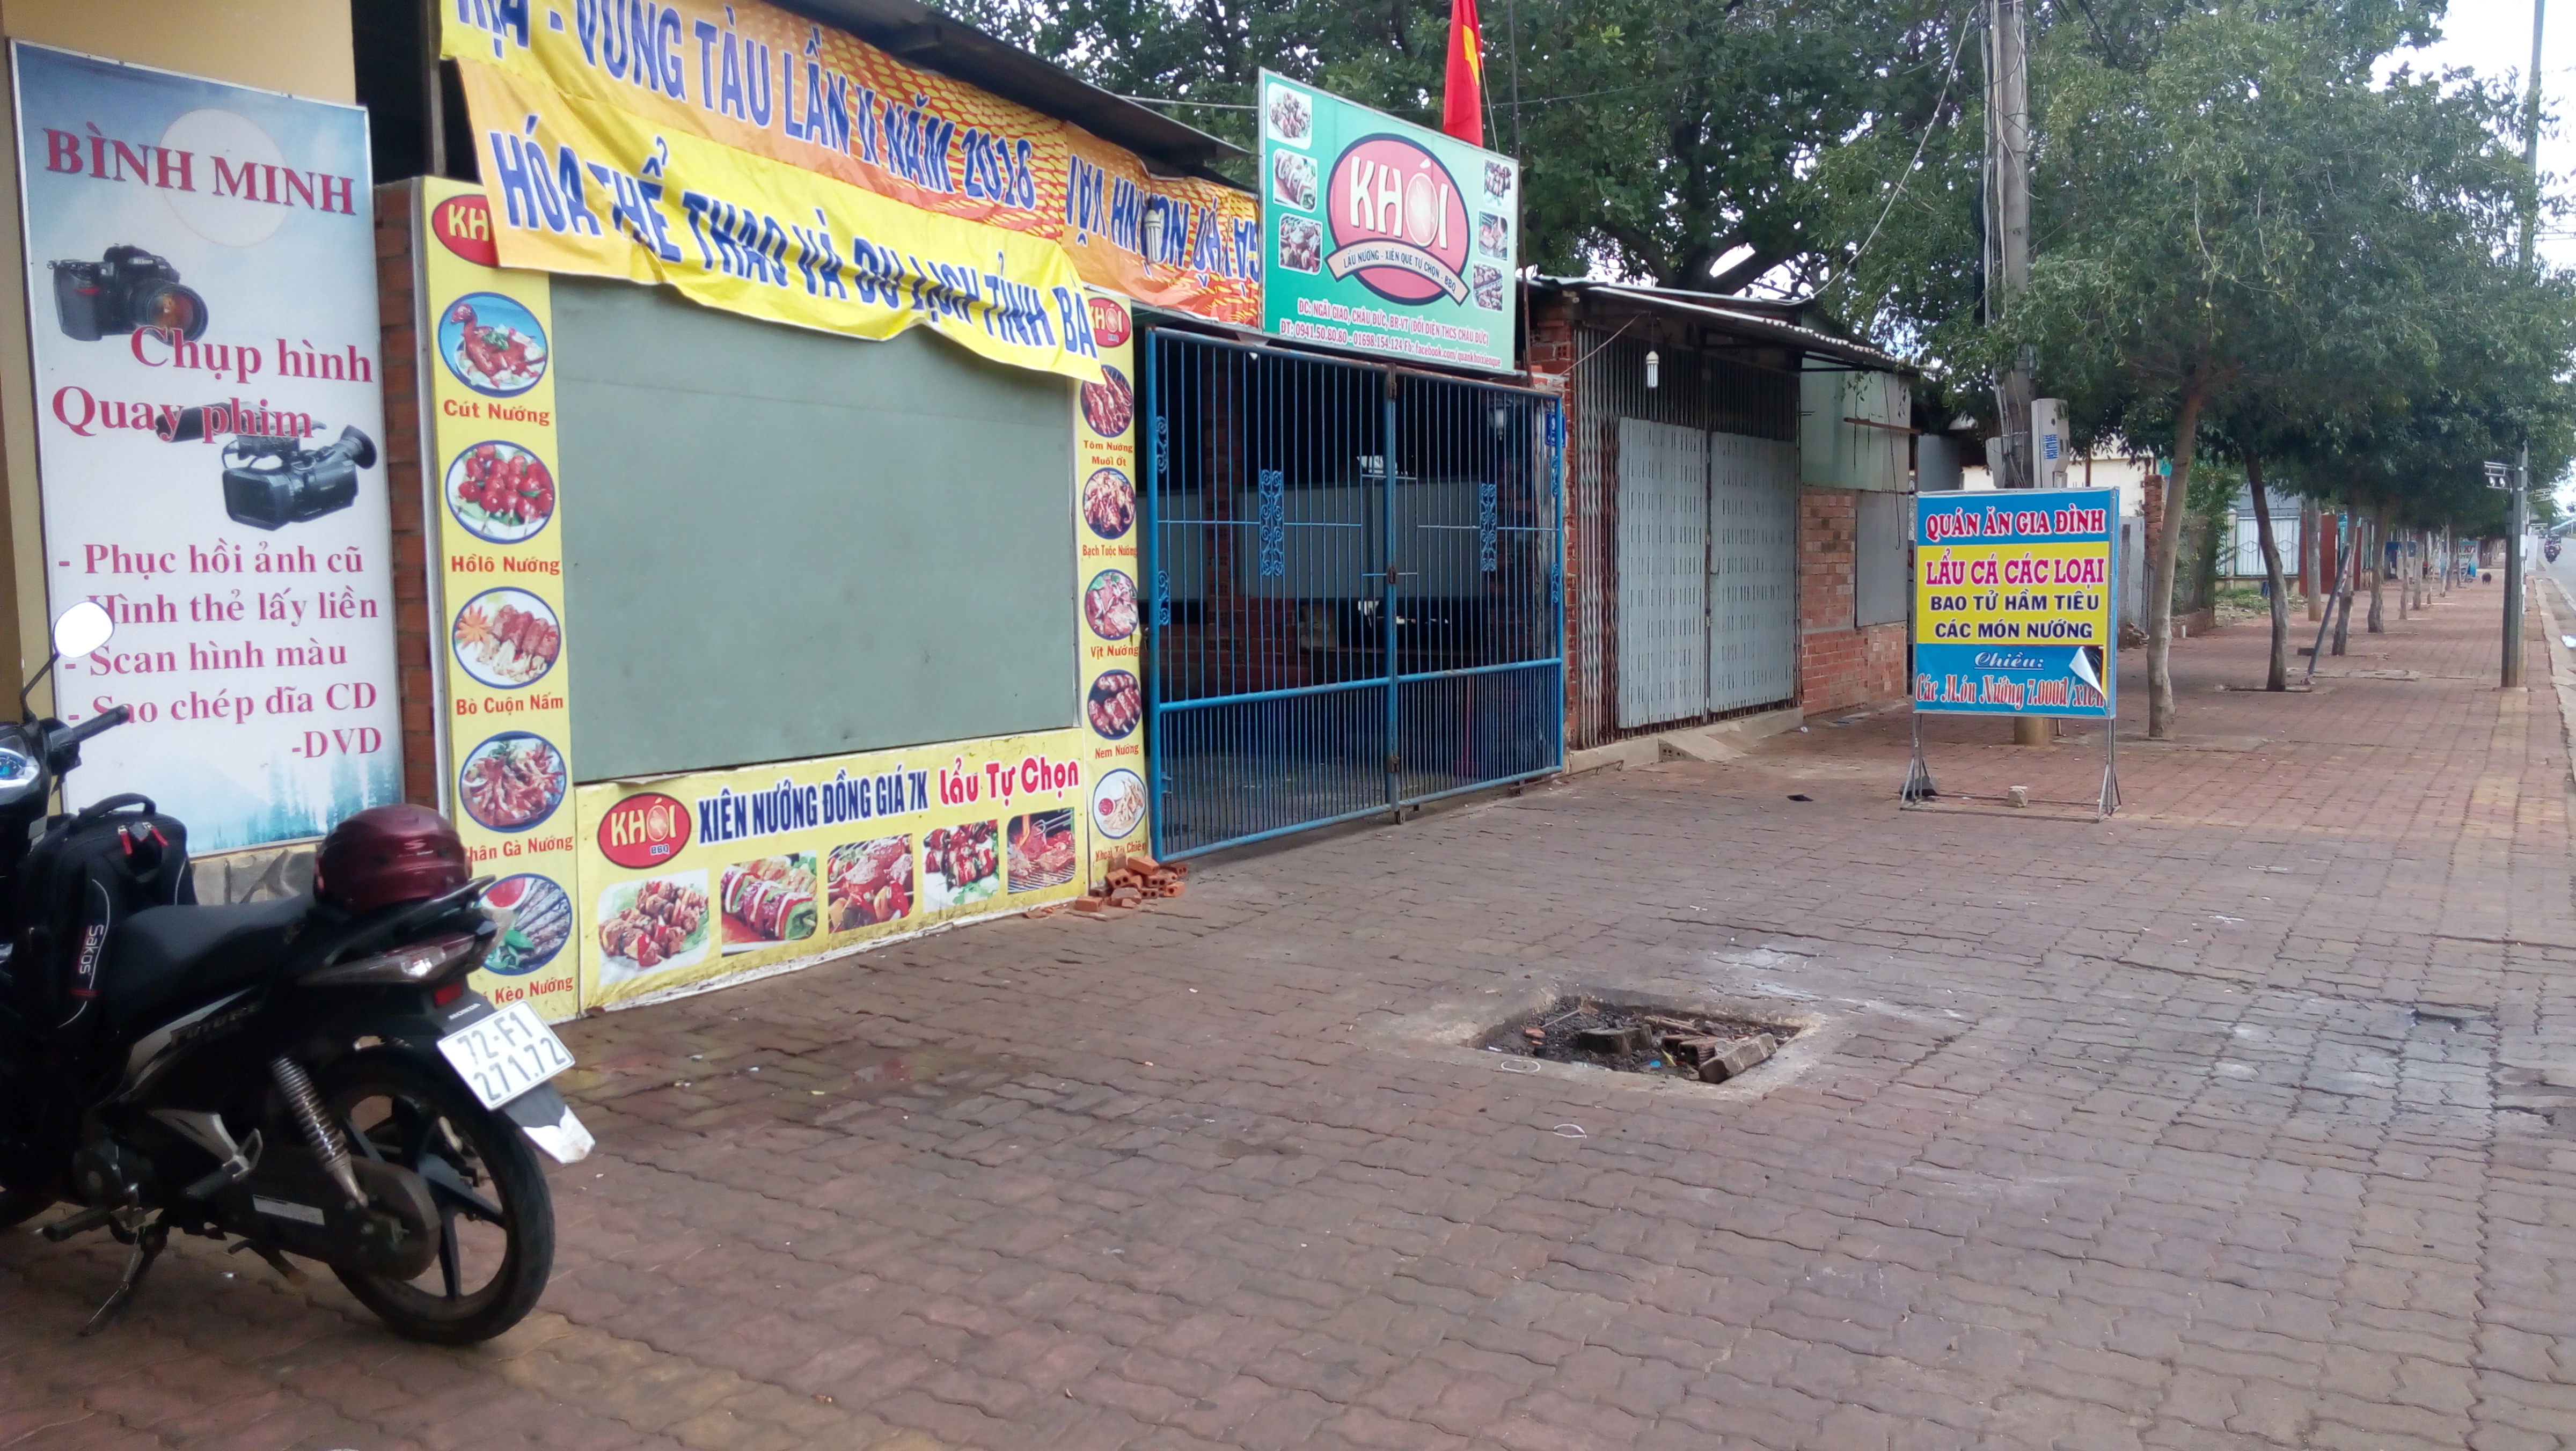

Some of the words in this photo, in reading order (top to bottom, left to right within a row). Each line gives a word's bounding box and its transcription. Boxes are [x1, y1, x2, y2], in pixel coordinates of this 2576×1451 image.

[694, 5, 773, 129] TÀU
[782, 26, 850, 157] LẦN
[883, 92, 955, 193] NĂM
[960, 127, 1036, 211] 2016
[42, 121, 196, 192] BÌNH
[210, 156, 357, 216] MINH
[448, 203, 489, 241] KH
[1350, 156, 1450, 249] KHÓI
[489, 114, 604, 236] HÓA
[584, 135, 684, 262] THỂ
[680, 190, 789, 287] THAO
[793, 207, 848, 299] VÀ
[853, 236, 904, 310] DU
[907, 254, 981, 326] LỊCH
[983, 250, 1057, 347] TỈNH
[1051, 273, 1099, 360] BÀ
[1343, 249, 1356, 268] LẨU
[1358, 246, 1380, 262] NƯỚNG
[1401, 252, 1413, 265] QUE
[1415, 257, 1423, 270] TỰ
[1424, 261, 1441, 279] CHỌN
[1444, 275, 1456, 294] BBQ
[1296, 323, 1347, 343] 0941.50.80.80
[1353, 332, 1402, 351] 01698.154.124
[1332, 306, 1350, 322] GIAO,
[1352, 308, 1371, 323] CHÂU
[1390, 316, 1409, 331] BR-VT
[1442, 325, 1457, 339] THCS
[1458, 328, 1474, 342] CHÂU
[130, 325, 262, 384] Chụp
[277, 339, 374, 383] hình
[53, 385, 184, 443] Quay
[202, 397, 314, 444] phim
[444, 399, 480, 418] Cút
[488, 402, 550, 426] Nướng
[1084, 440, 1103, 450] Tôm
[1107, 442, 1133, 453] Nướng
[1926, 507, 1980, 542] QUÁN
[1982, 507, 2013, 536] ĂN
[2015, 510, 2052, 534] GIA
[2054, 503, 2106, 534] ĐÌNH
[83, 544, 176, 580] Phục
[189, 538, 244, 573] hồi
[255, 540, 317, 573] ảnh
[327, 546, 364, 573] cũ
[503, 556, 560, 575] Nướng
[1926, 548, 1965, 585] LẨU
[1970, 553, 1999, 585] CÁ
[2004, 552, 2049, 584] CÁC
[2053, 558, 2104, 589] LOẠI
[190, 589, 245, 622] thẻ
[258, 588, 307, 627] lấy
[318, 585, 379, 619] liền
[1930, 596, 1967, 611] BAO
[1973, 590, 1999, 610] TỬ
[2004, 588, 2047, 610] HẦM
[2054, 591, 2099, 610] TIÊU
[1935, 619, 1971, 638] CÁC
[1978, 619, 2020, 638] MÓN
[2026, 618, 2092, 639] NƯỚNG
[90, 645, 178, 676] Scan
[189, 640, 265, 671] hình
[276, 637, 347, 667] màu
[1091, 646, 1103, 659] Vịt
[1107, 644, 1139, 657] Nướng
[1974, 651, 2044, 669] Chiều:
[170, 688, 254, 724] chép
[265, 686, 314, 714] dĩa
[326, 681, 377, 711] CD
[456, 698, 477, 715] Bò
[484, 697, 524, 715] Cuộn
[530, 692, 563, 709] Nấm
[1916, 673, 1938, 702] Các
[1979, 675, 2024, 710] Nướng
[1095, 748, 1112, 759] Nem
[1115, 743, 1139, 756] Nướng
[610, 797, 677, 847] KHÓI
[698, 788, 748, 844] XIÊN
[752, 778, 818, 836] NƯỚNG
[822, 768, 872, 825] ĐỒNG
[876, 764, 906, 817] GIÁ
[908, 771, 929, 810] 7K
[986, 762, 1016, 807] Tự
[1020, 757, 1079, 799] Chọn
[503, 840, 521, 857] Gà
[528, 835, 573, 853] Nướng
[79, 924, 105, 975] Sakos
[495, 986, 523, 1004] Kèo
[530, 977, 573, 996] Nướng
[474, 1037, 566, 1101] 271.72
